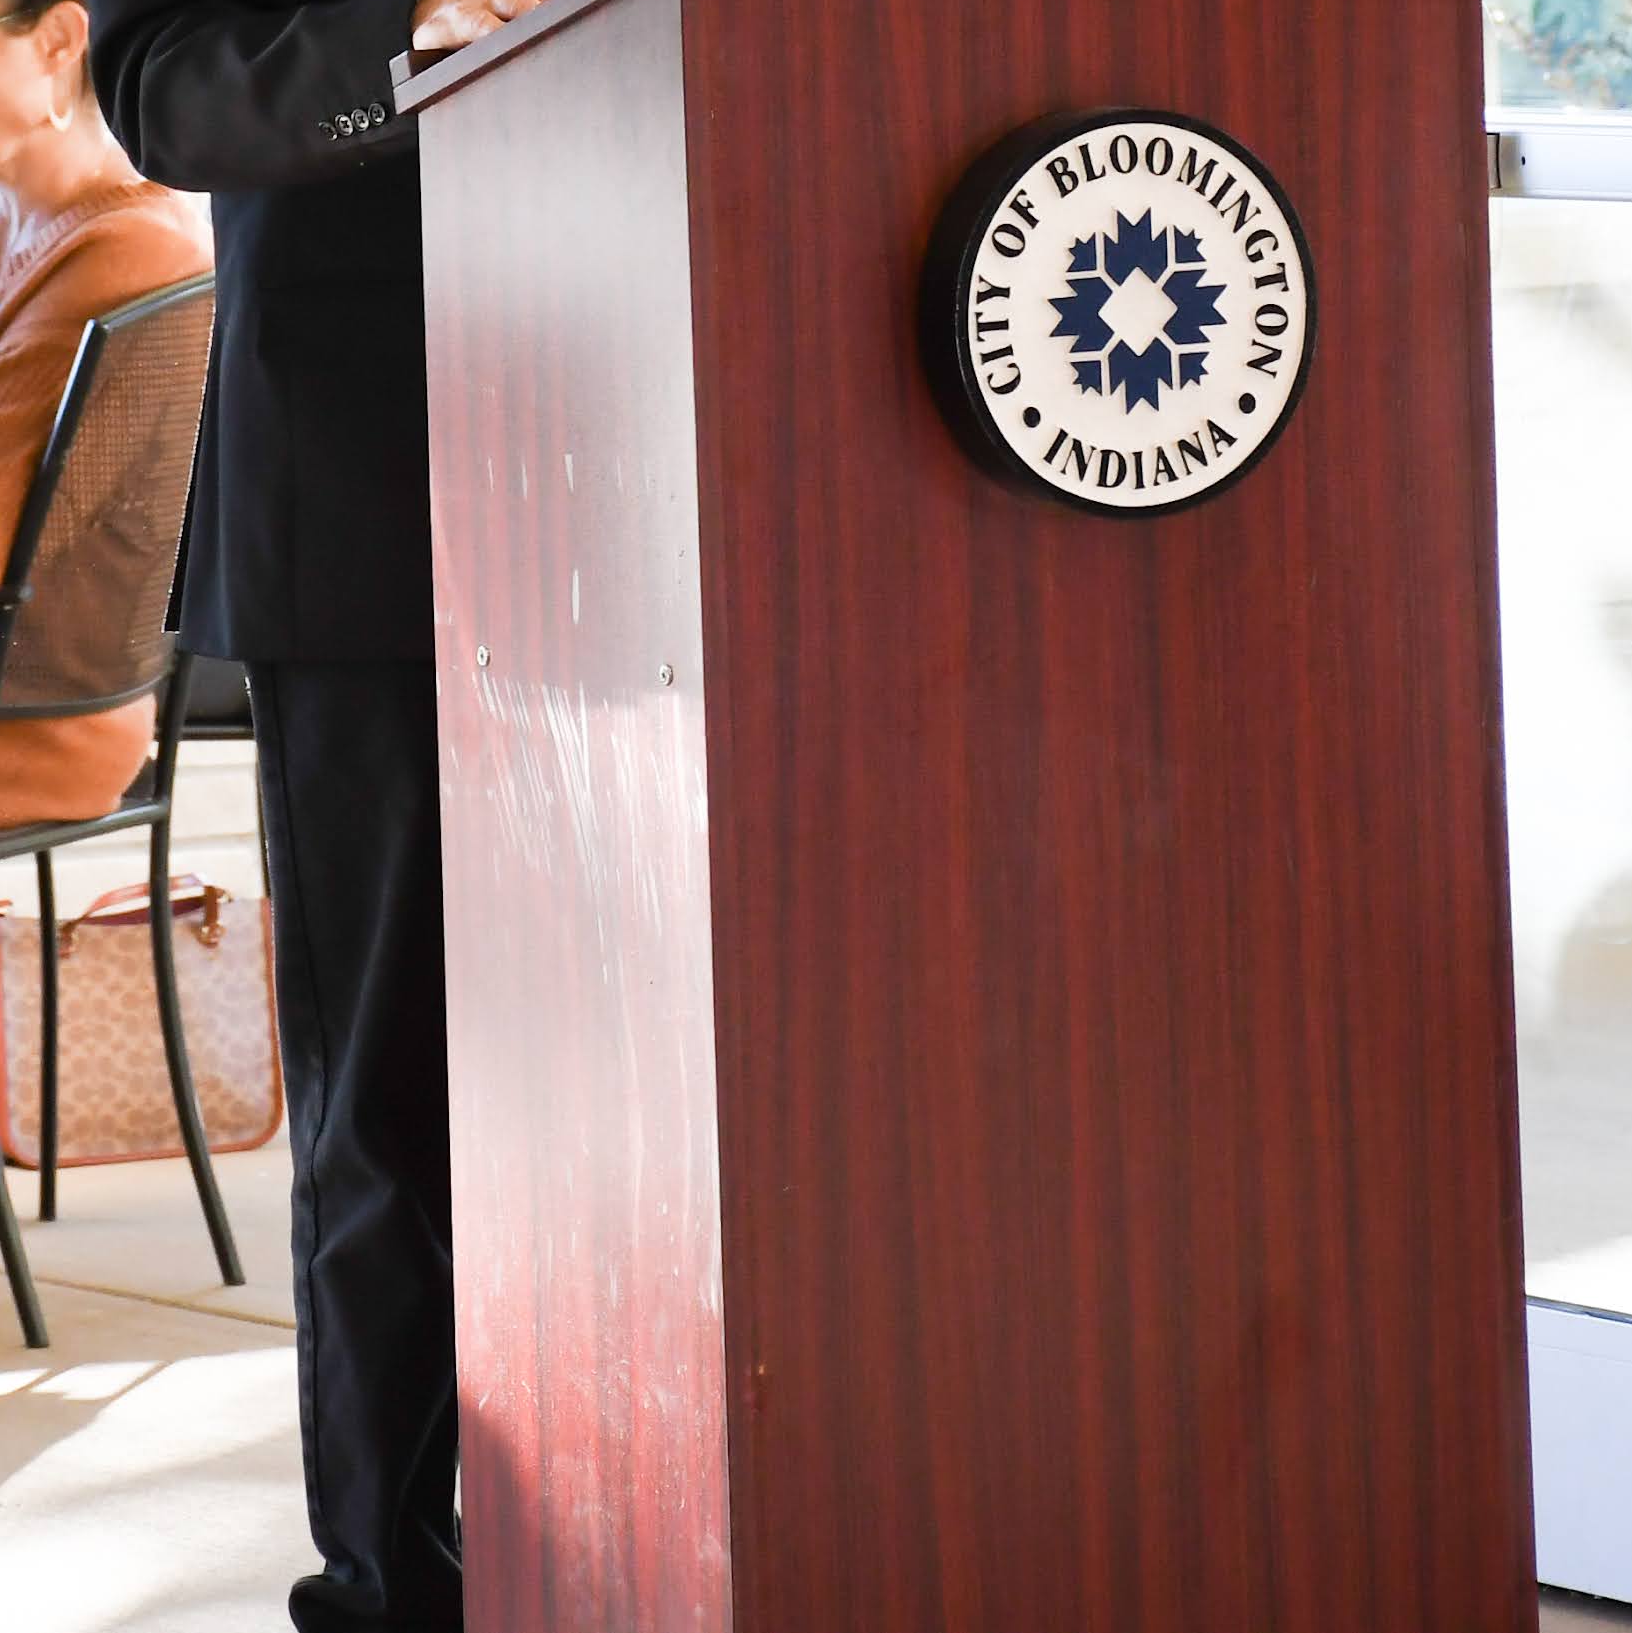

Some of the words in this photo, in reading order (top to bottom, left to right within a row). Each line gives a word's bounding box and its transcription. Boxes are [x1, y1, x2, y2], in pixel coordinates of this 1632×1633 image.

[990, 189, 1040, 258] OF
[1045, 134, 1290, 379] BLOOMINGTON
[974, 275, 1022, 395] CITY
[1042, 418, 1238, 490] INDIANA
